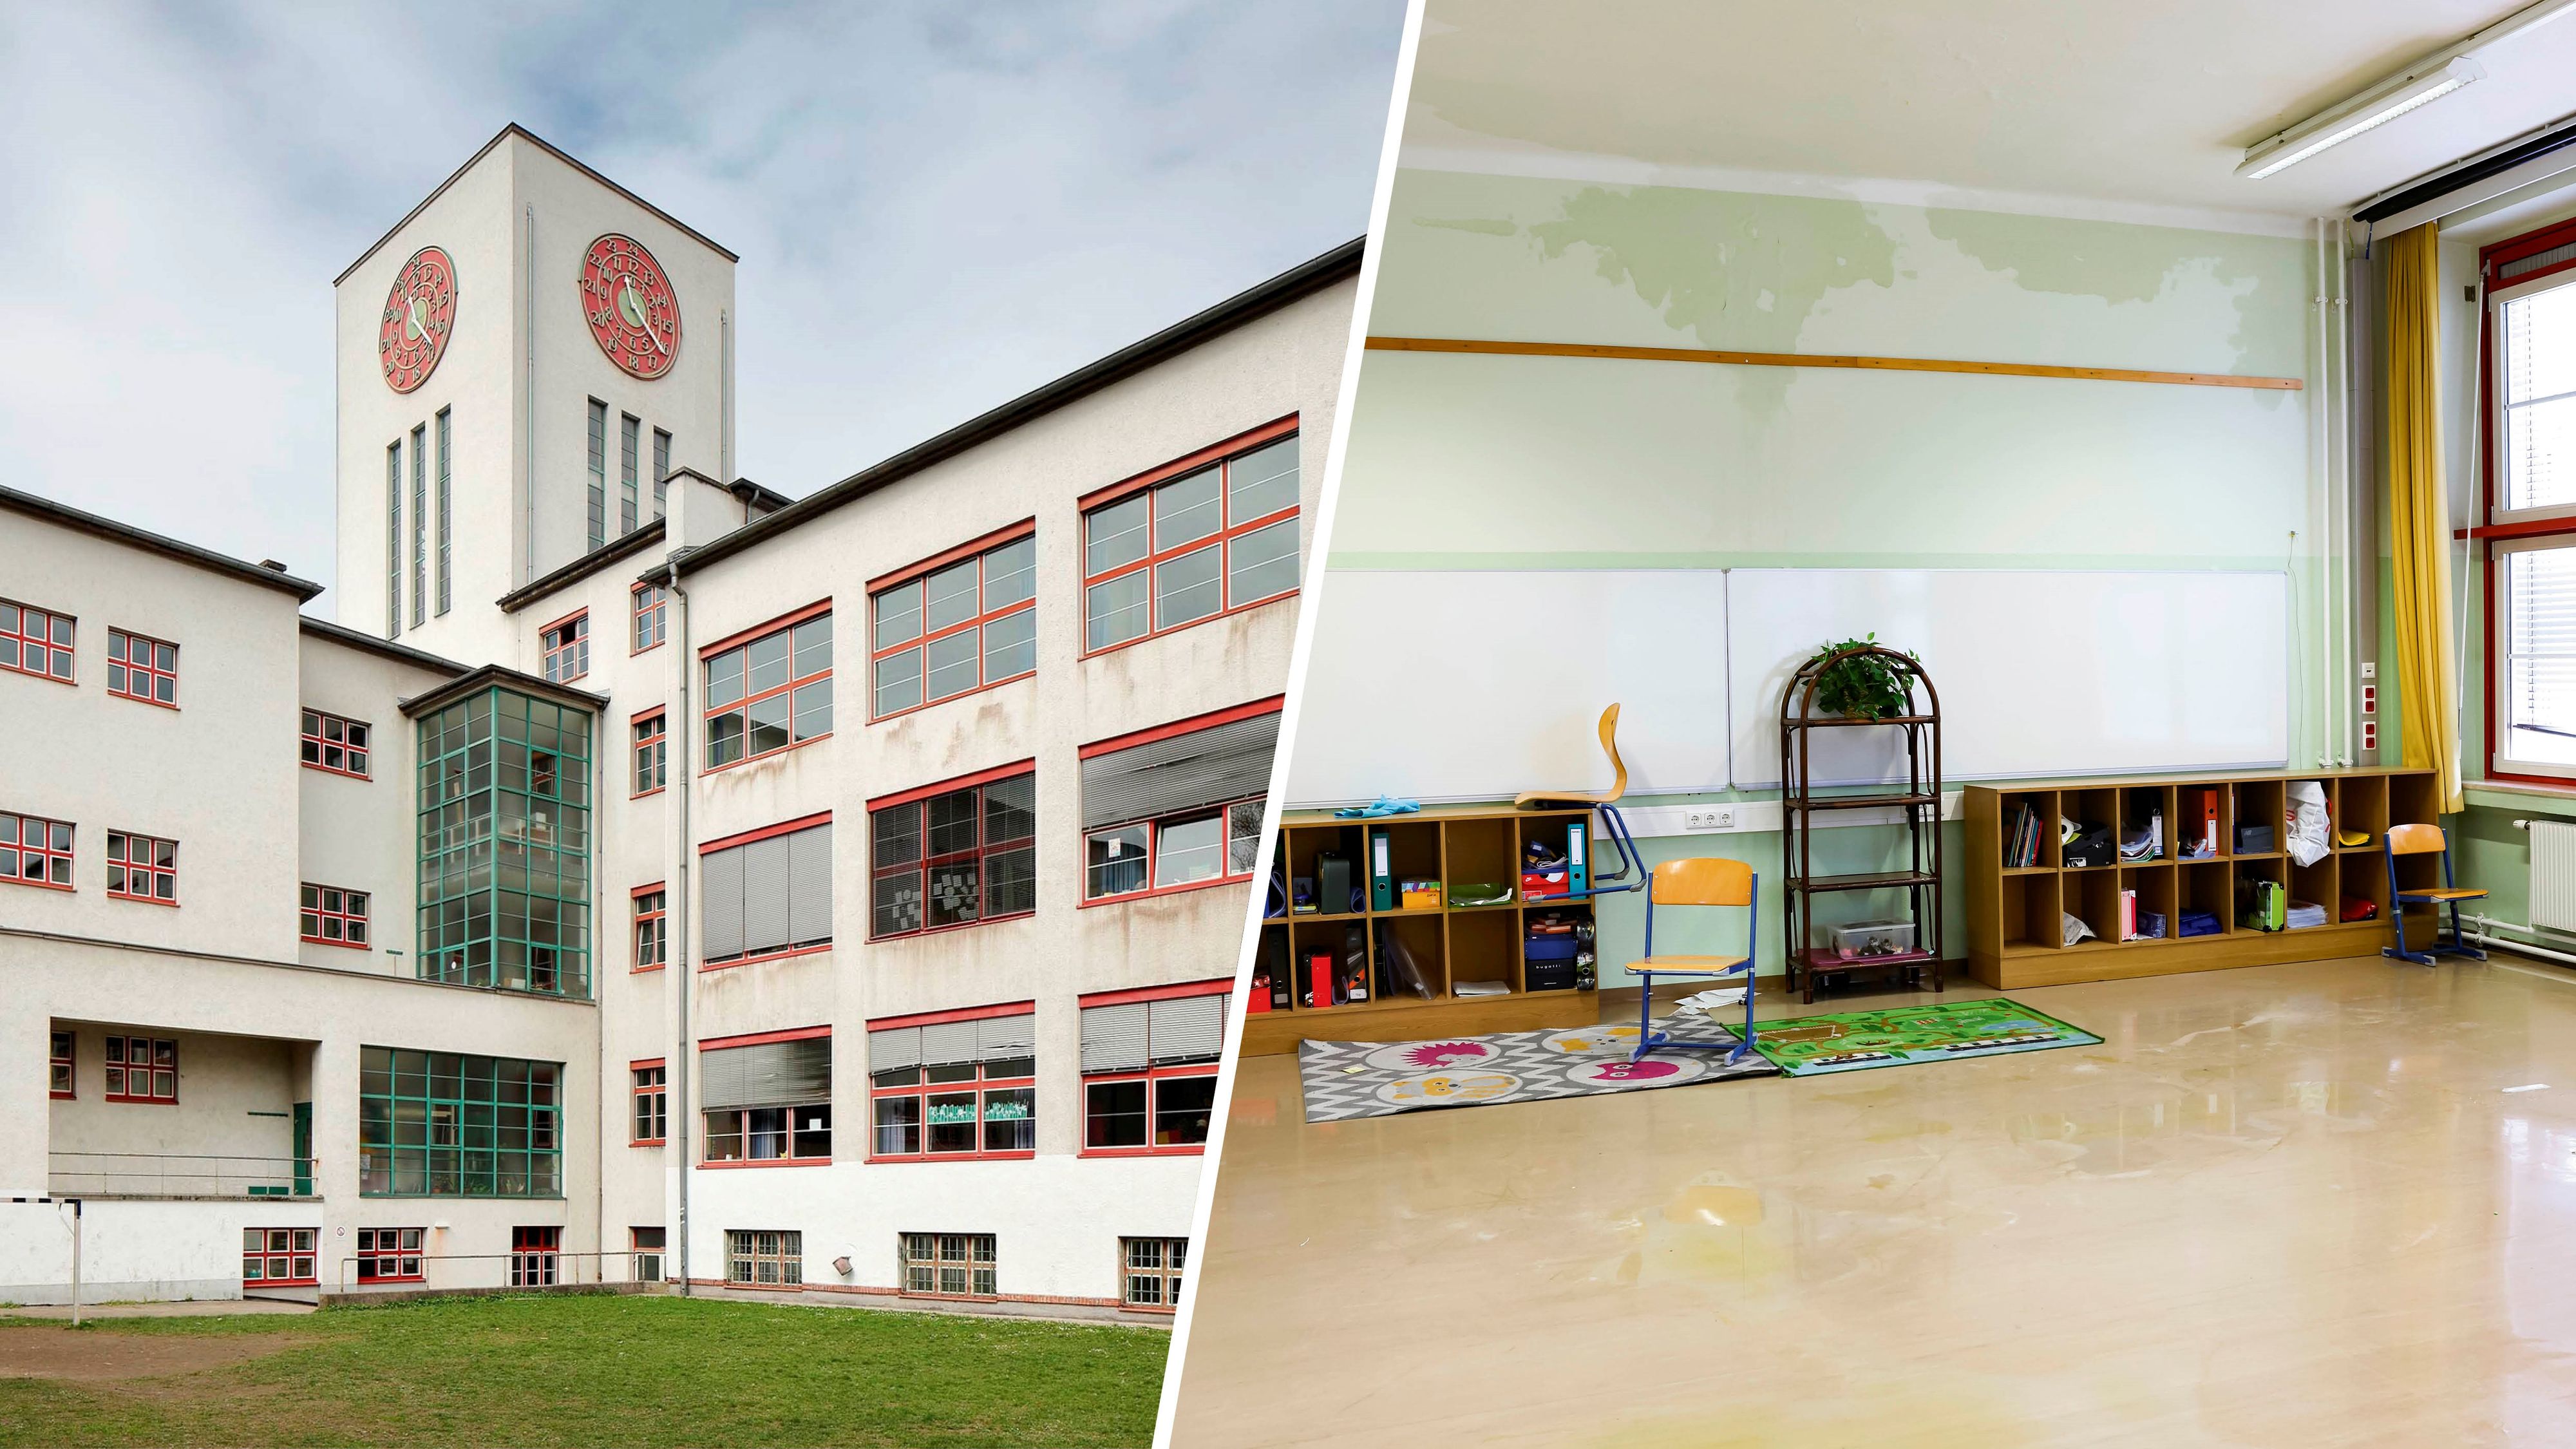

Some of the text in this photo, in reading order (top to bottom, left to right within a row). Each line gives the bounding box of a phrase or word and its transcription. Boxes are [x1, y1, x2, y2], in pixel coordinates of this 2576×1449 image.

[606, 239, 617, 252] 23
[627, 242, 638, 256] 24
[589, 252, 602, 268] 22
[613, 255, 621, 271] 11
[628, 257, 639, 274] 12
[603, 267, 612, 283] 10
[629, 275, 636, 288] 0
[644, 270, 654, 285] 13
[584, 278, 596, 294] 21
[600, 286, 607, 299] 9
[641, 285, 646, 295] 1
[649, 296, 656, 309] 2
[657, 292, 667, 308] 14
[591, 310, 605, 327] 20
[605, 307, 612, 321] 8
[652, 313, 658, 325] 3
[616, 325, 623, 339] 7
[662, 319, 672, 333] 15
[607, 337, 617, 352] 19
[630, 336, 636, 349] 6
[642, 337, 649, 350] 5
[404, 351, 409, 366] 7
[627, 355, 638, 370] 18
[647, 355, 658, 369] 17
